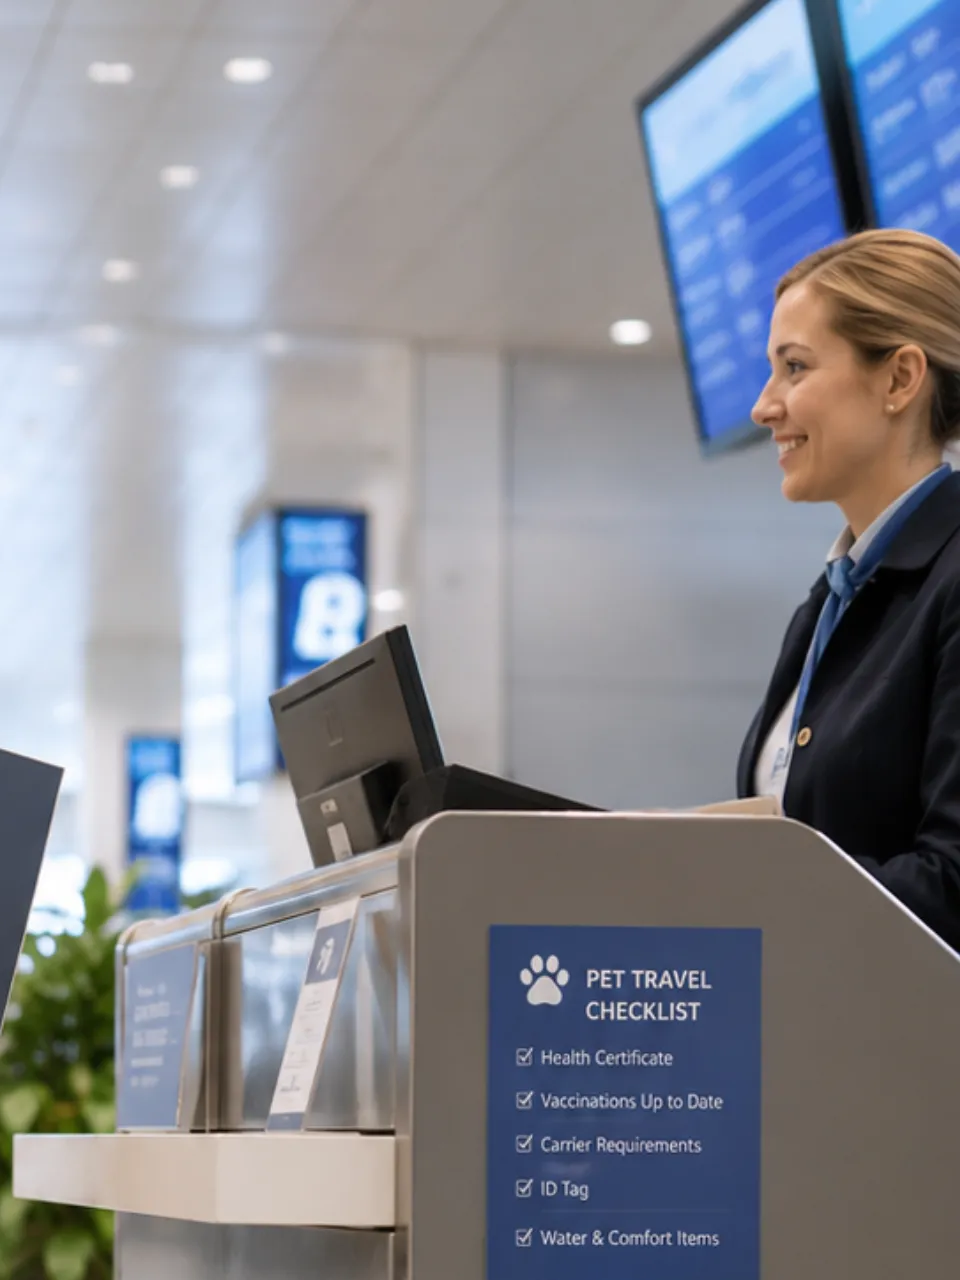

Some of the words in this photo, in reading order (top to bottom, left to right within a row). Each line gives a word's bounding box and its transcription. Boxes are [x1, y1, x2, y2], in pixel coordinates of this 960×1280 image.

[586, 969, 626, 989] PET
[631, 969, 712, 989] TRAVEL
[585, 1001, 701, 1021] CHECKLIST
[541, 1049, 591, 1066] Health
[594, 1049, 674, 1067] Certificate
[540, 1092, 637, 1110] Vaccinations
[640, 1093, 664, 1113] Up
[667, 1095, 684, 1110] to
[687, 1093, 724, 1110] Date
[540, 1135, 592, 1153] Carrier
[596, 1136, 702, 1156] Requirements
[540, 1180, 558, 1197] ID
[561, 1179, 589, 1201] Tag
[540, 1230, 588, 1246] Water
[591, 1229, 604, 1246] &
[607, 1228, 673, 1246] Comfort
[676, 1230, 720, 1247] Items
